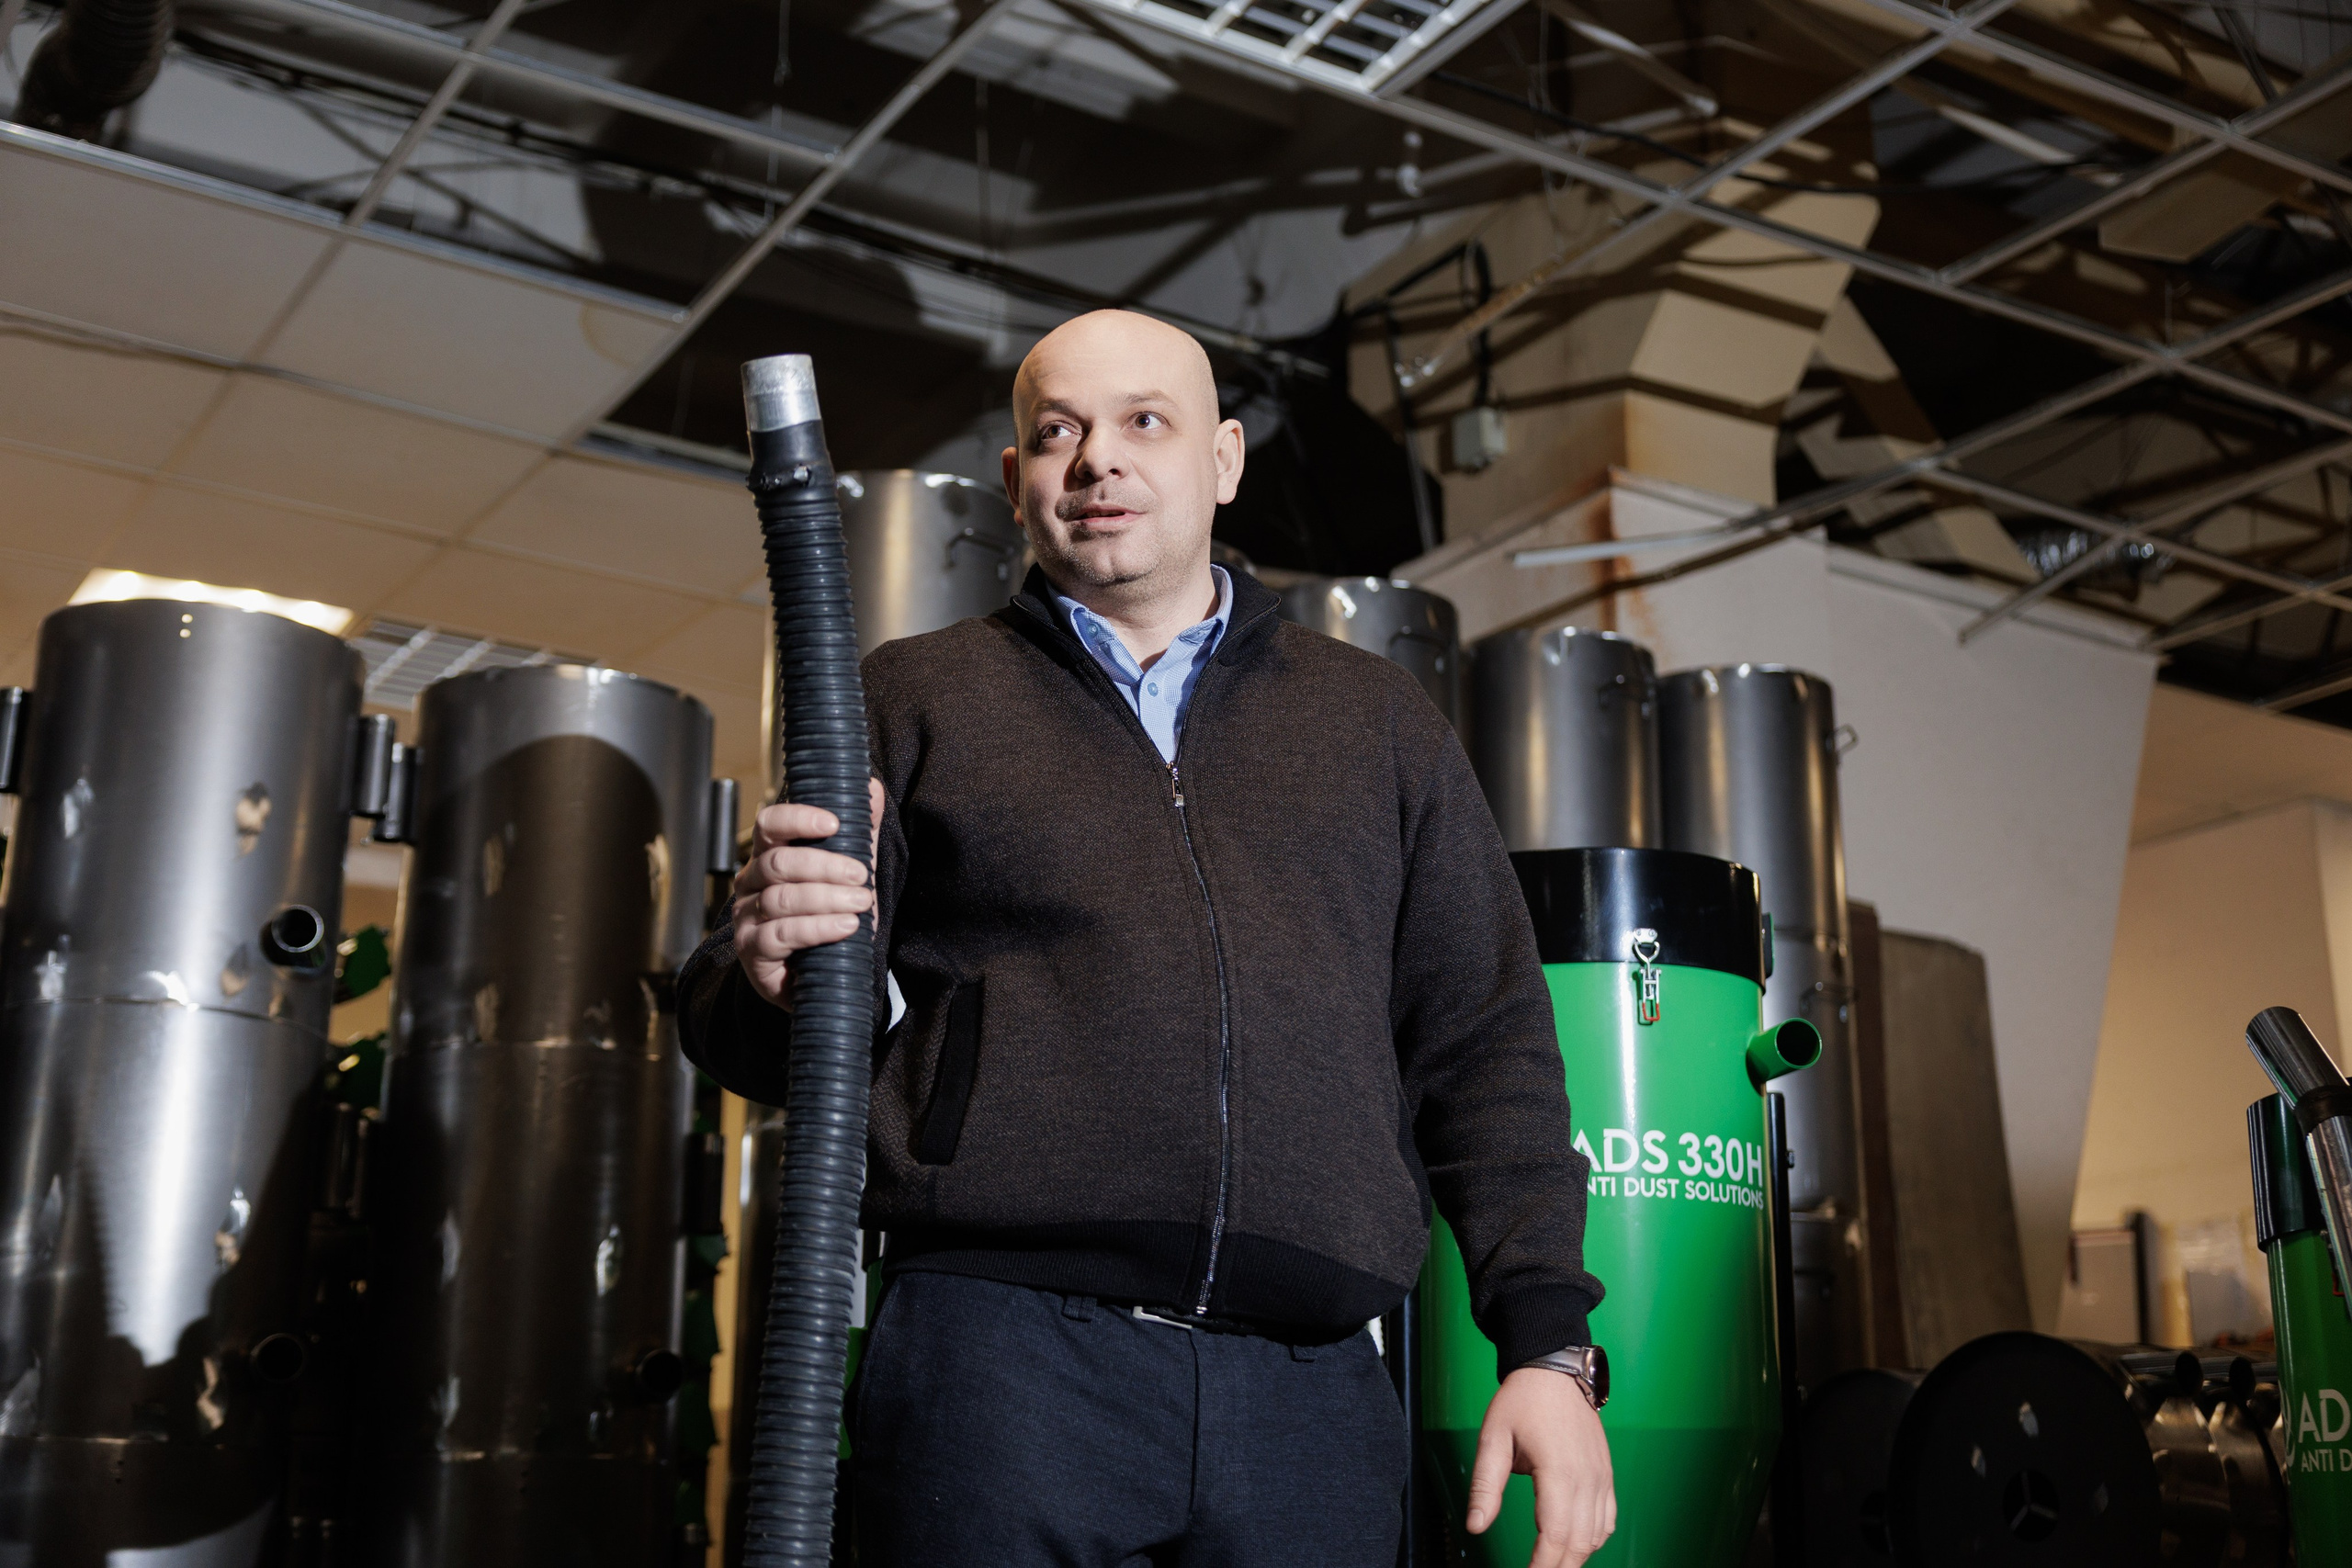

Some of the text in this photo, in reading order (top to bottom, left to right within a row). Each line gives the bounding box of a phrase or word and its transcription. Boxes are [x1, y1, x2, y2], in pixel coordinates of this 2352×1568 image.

[1572, 1128, 1763, 1189] ADS 330H
[1587, 1176, 1764, 1211] NTI DUST SOLUTIONS
[2298, 1388, 2352, 1443] AD
[2301, 1449, 2335, 1472] ANTI
